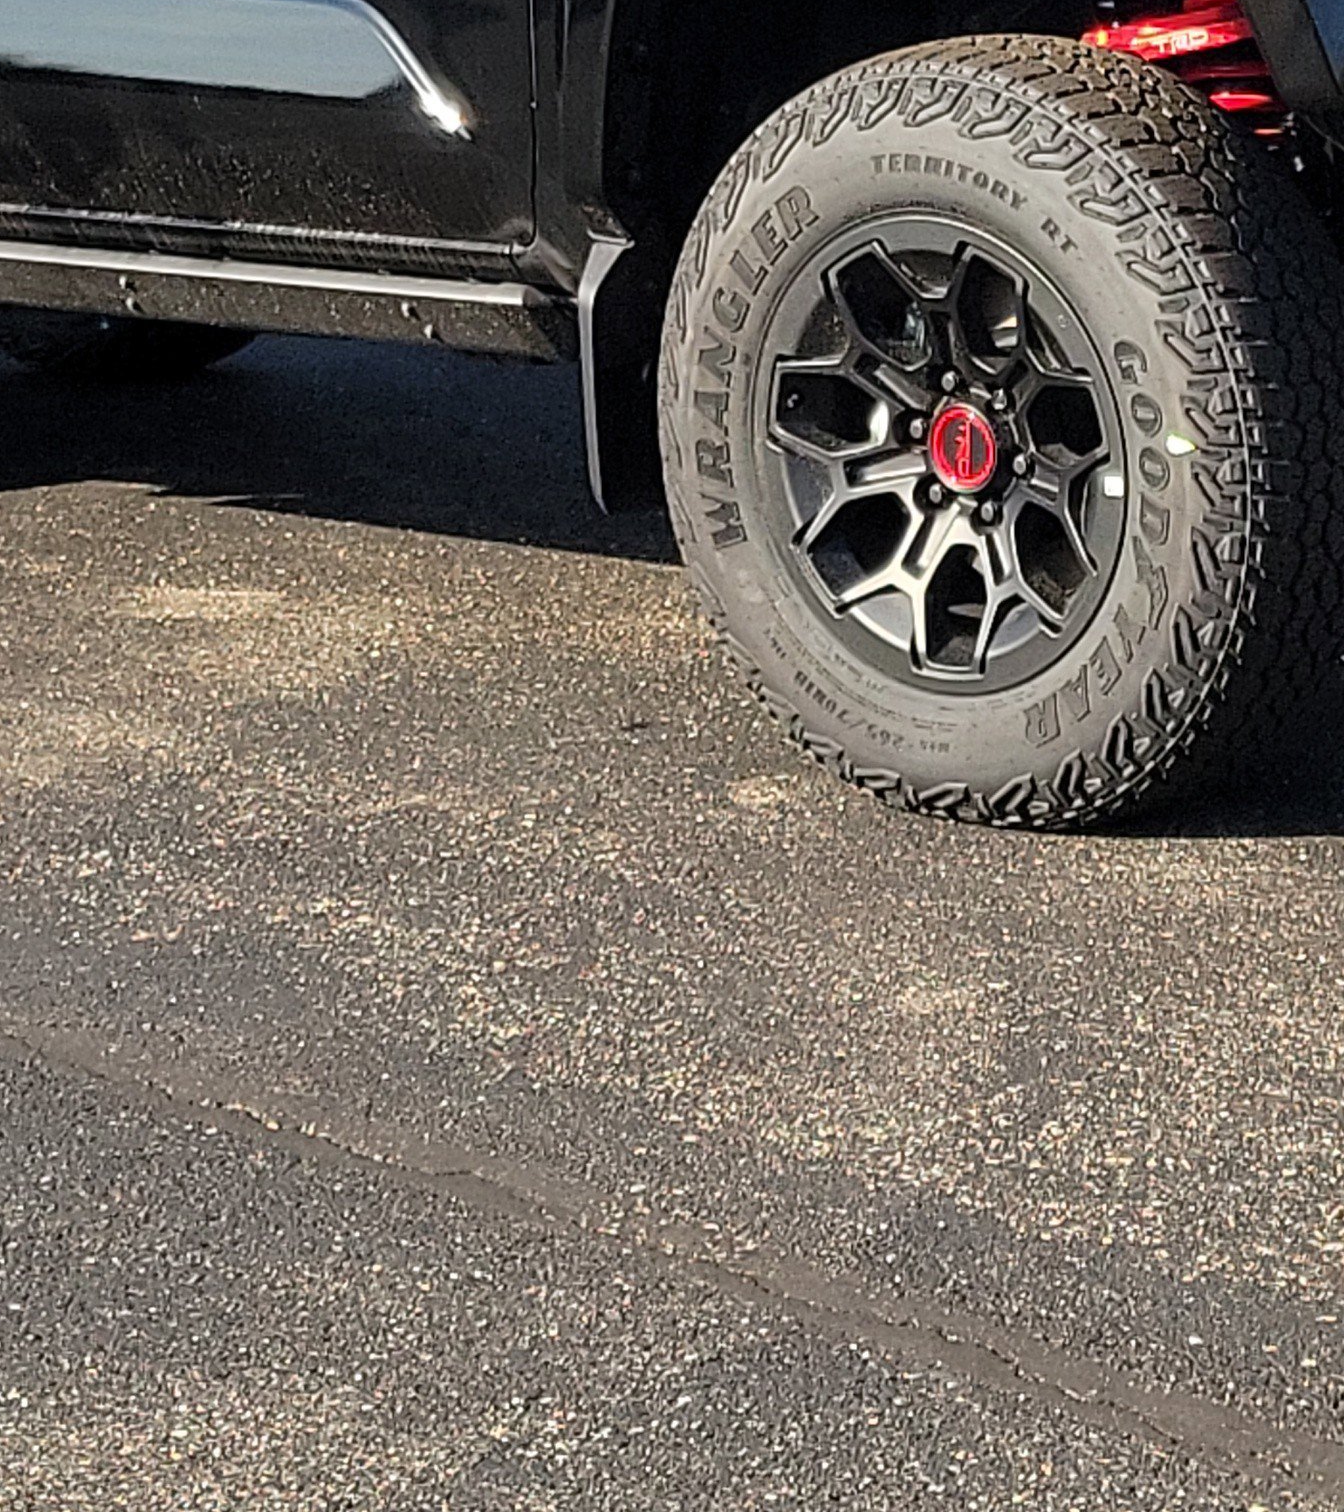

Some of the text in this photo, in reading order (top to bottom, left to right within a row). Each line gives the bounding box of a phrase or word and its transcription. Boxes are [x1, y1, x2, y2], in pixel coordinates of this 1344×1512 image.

[693, 185, 820, 549] WRANGLER
[870, 152, 1079, 254] TERRITORY RT
[1023, 339, 1170, 748] GOODYEAR
